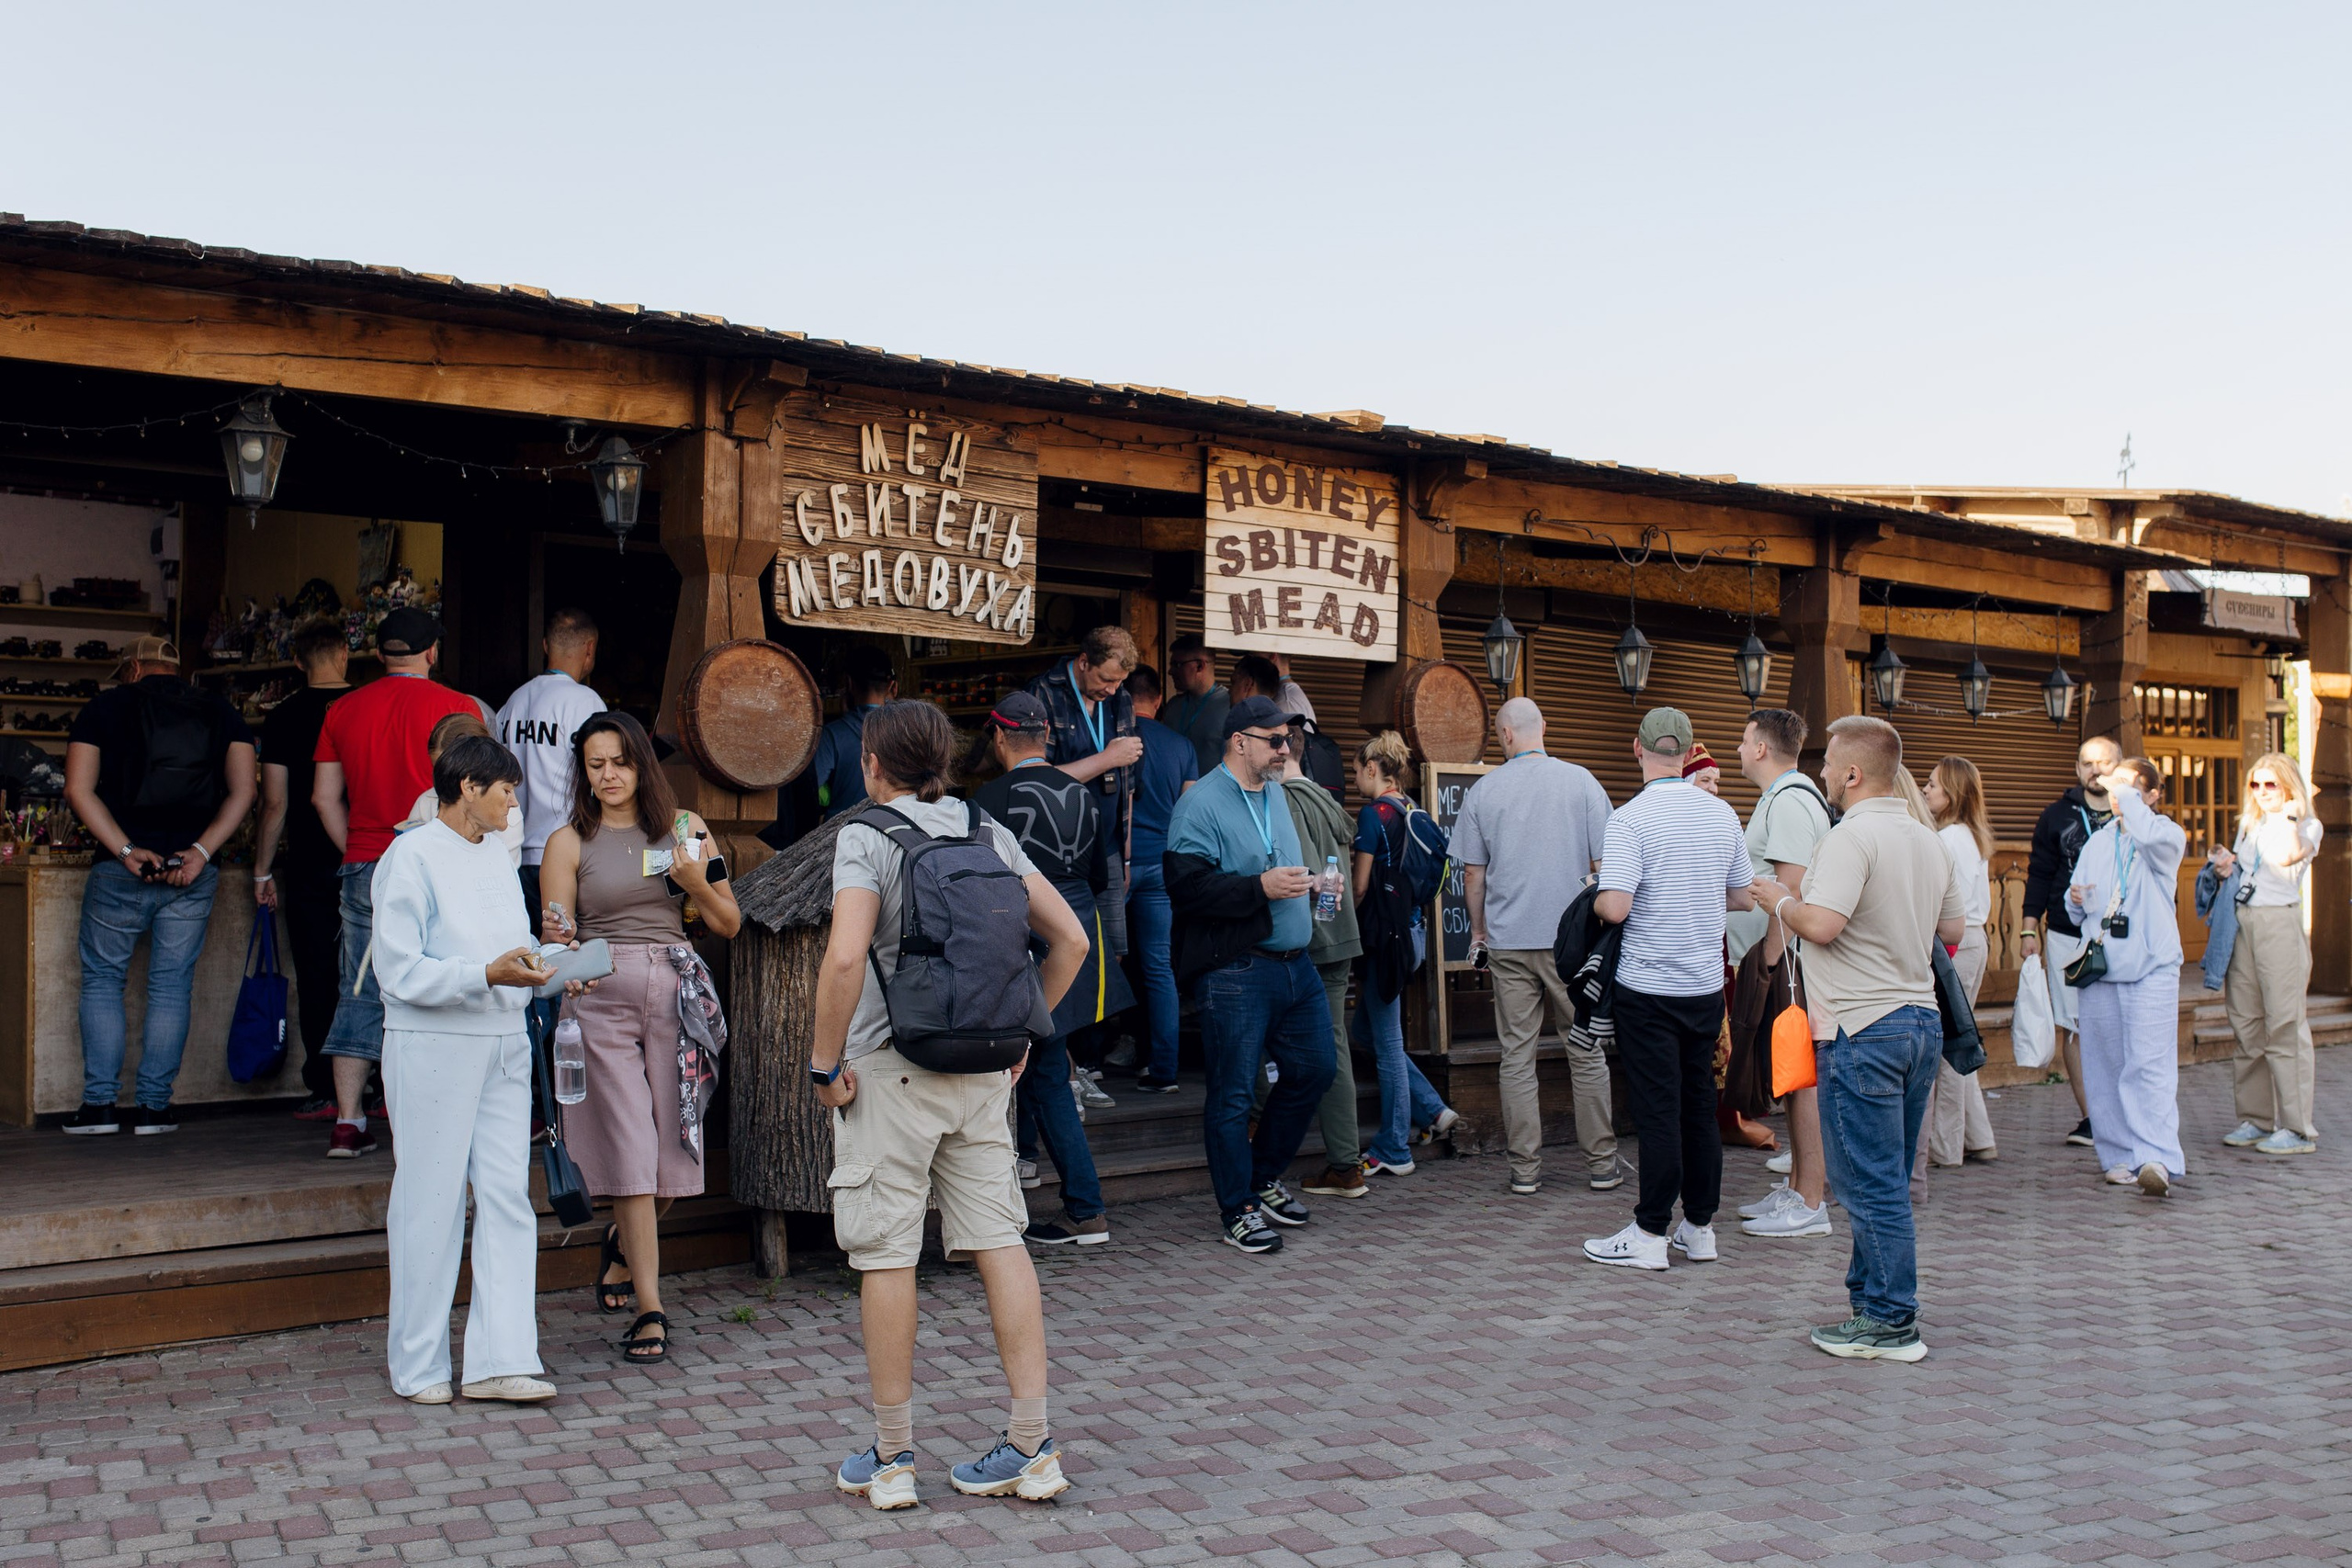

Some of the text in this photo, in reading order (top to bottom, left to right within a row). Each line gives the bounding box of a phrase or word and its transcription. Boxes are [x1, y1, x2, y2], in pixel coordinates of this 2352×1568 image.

[861, 409, 970, 488] МЁД
[797, 481, 1023, 569] СБИТЕНЬ
[1218, 464, 1393, 532] HONEY
[786, 549, 1031, 637] МЕДОВУХА
[1216, 527, 1392, 595] SBITEN
[1227, 586, 1380, 648] MEAD
